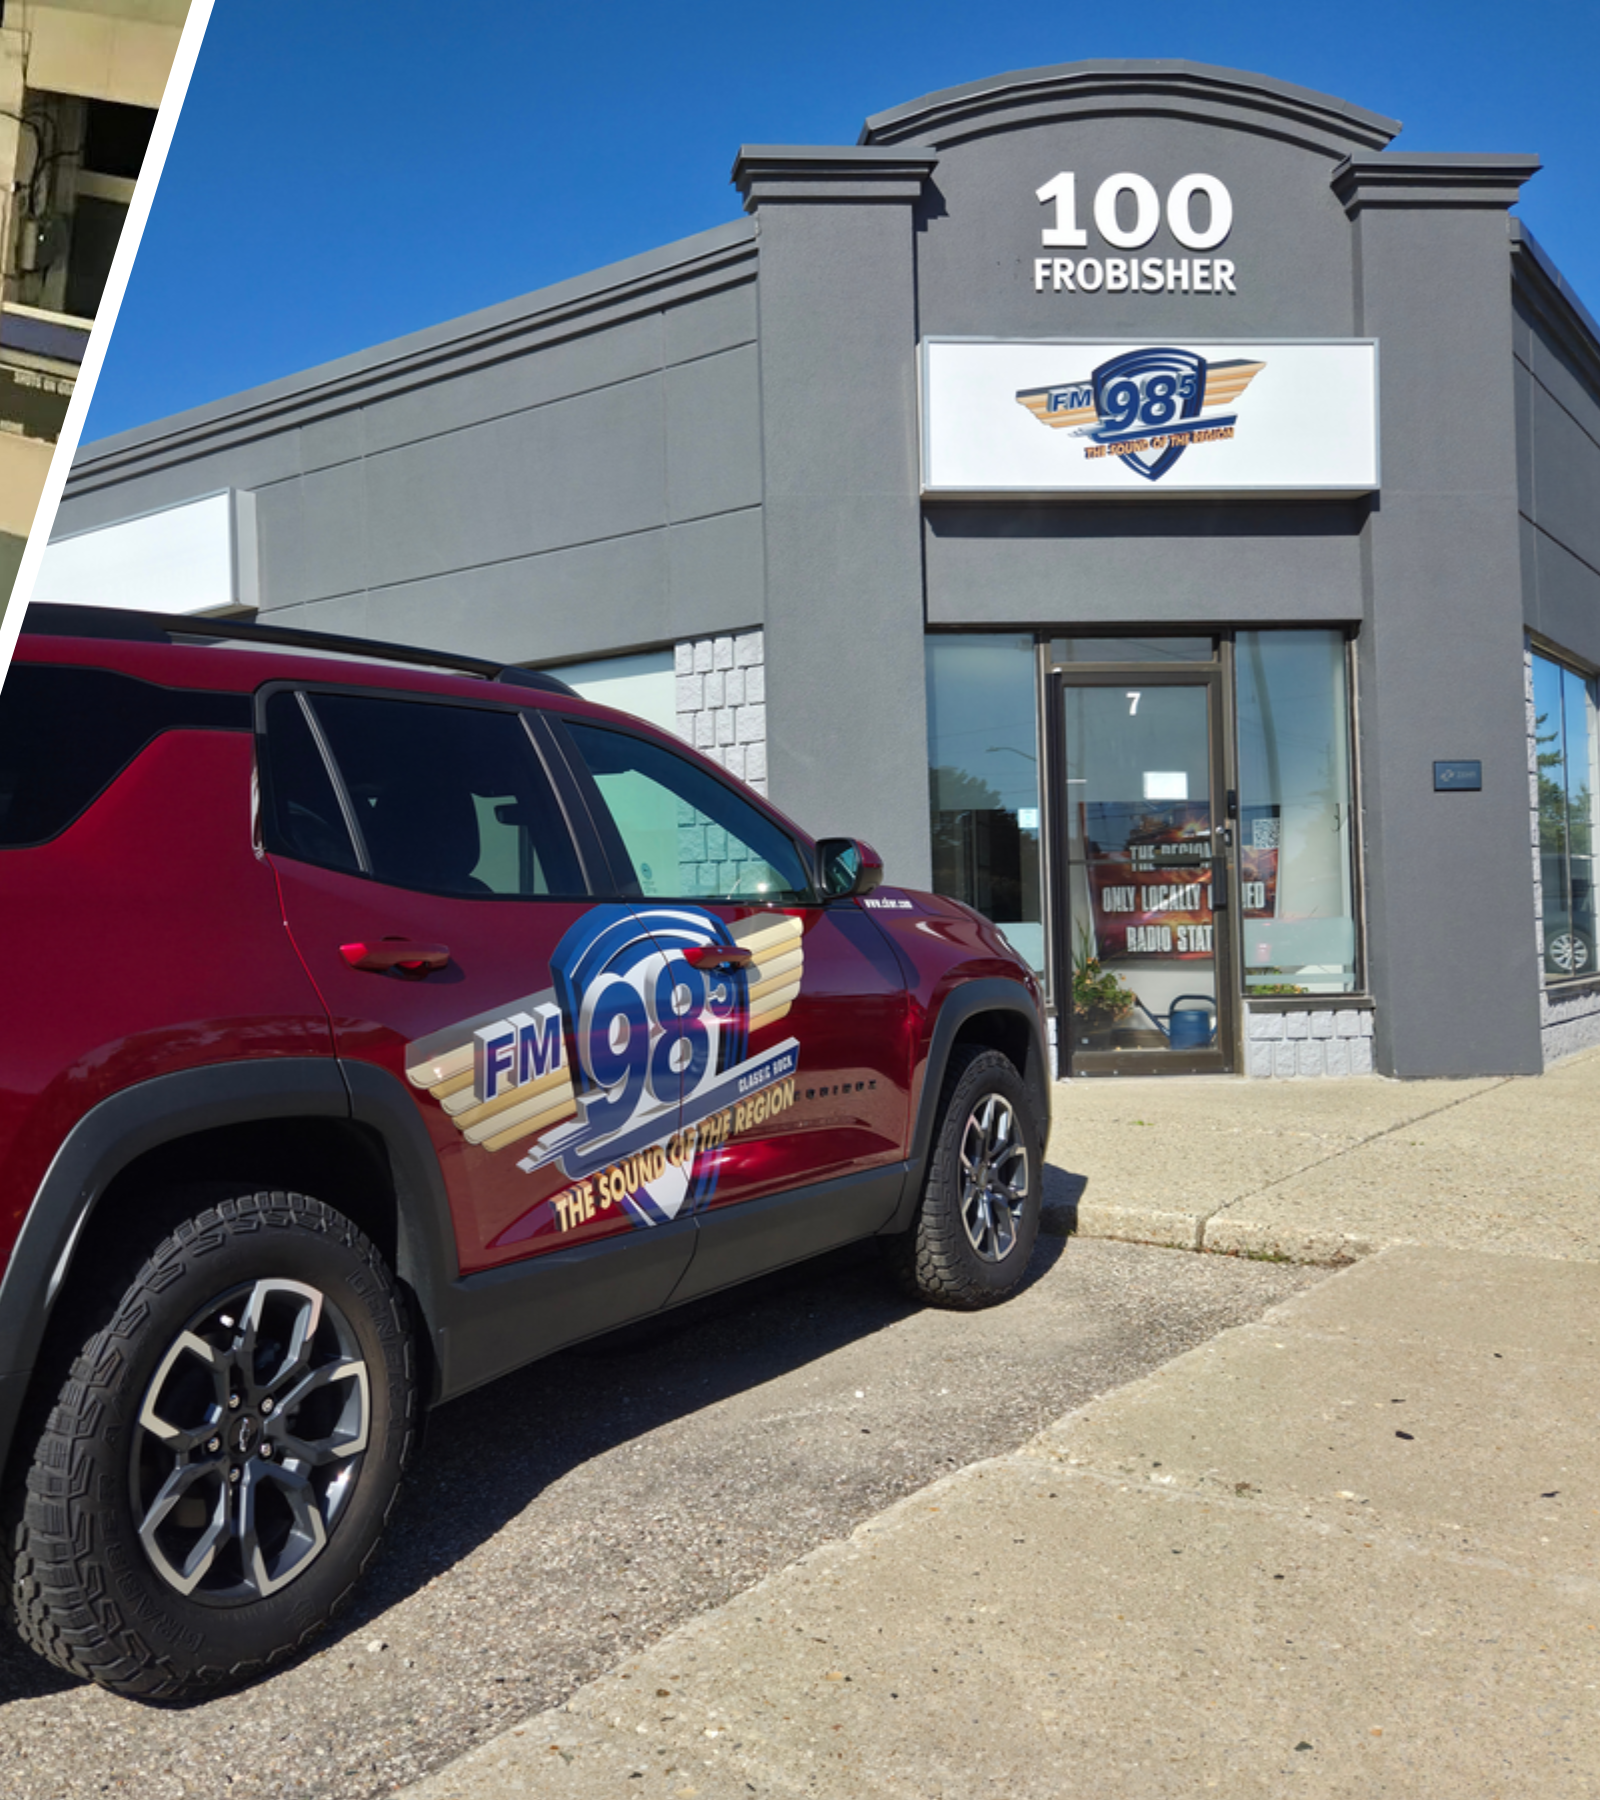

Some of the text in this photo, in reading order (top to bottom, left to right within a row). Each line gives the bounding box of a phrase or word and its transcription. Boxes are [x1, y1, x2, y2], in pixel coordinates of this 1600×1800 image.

[1035, 171, 1233, 250] 100
[1034, 258, 1237, 292] FROBISHER
[1046, 384, 1092, 412] FM
[1084, 427, 1235, 460] THE SOUND OF THE REGION
[1126, 691, 1141, 716] 7
[1103, 886, 1136, 912] ONLY
[1141, 882, 1200, 912] LOCALLY
[1126, 925, 1172, 953] RADIO
[476, 1004, 562, 1103] FM
[738, 1054, 793, 1093] CLASSIC ROCK
[551, 1078, 796, 1233] THE SOUND OF THE REGION
